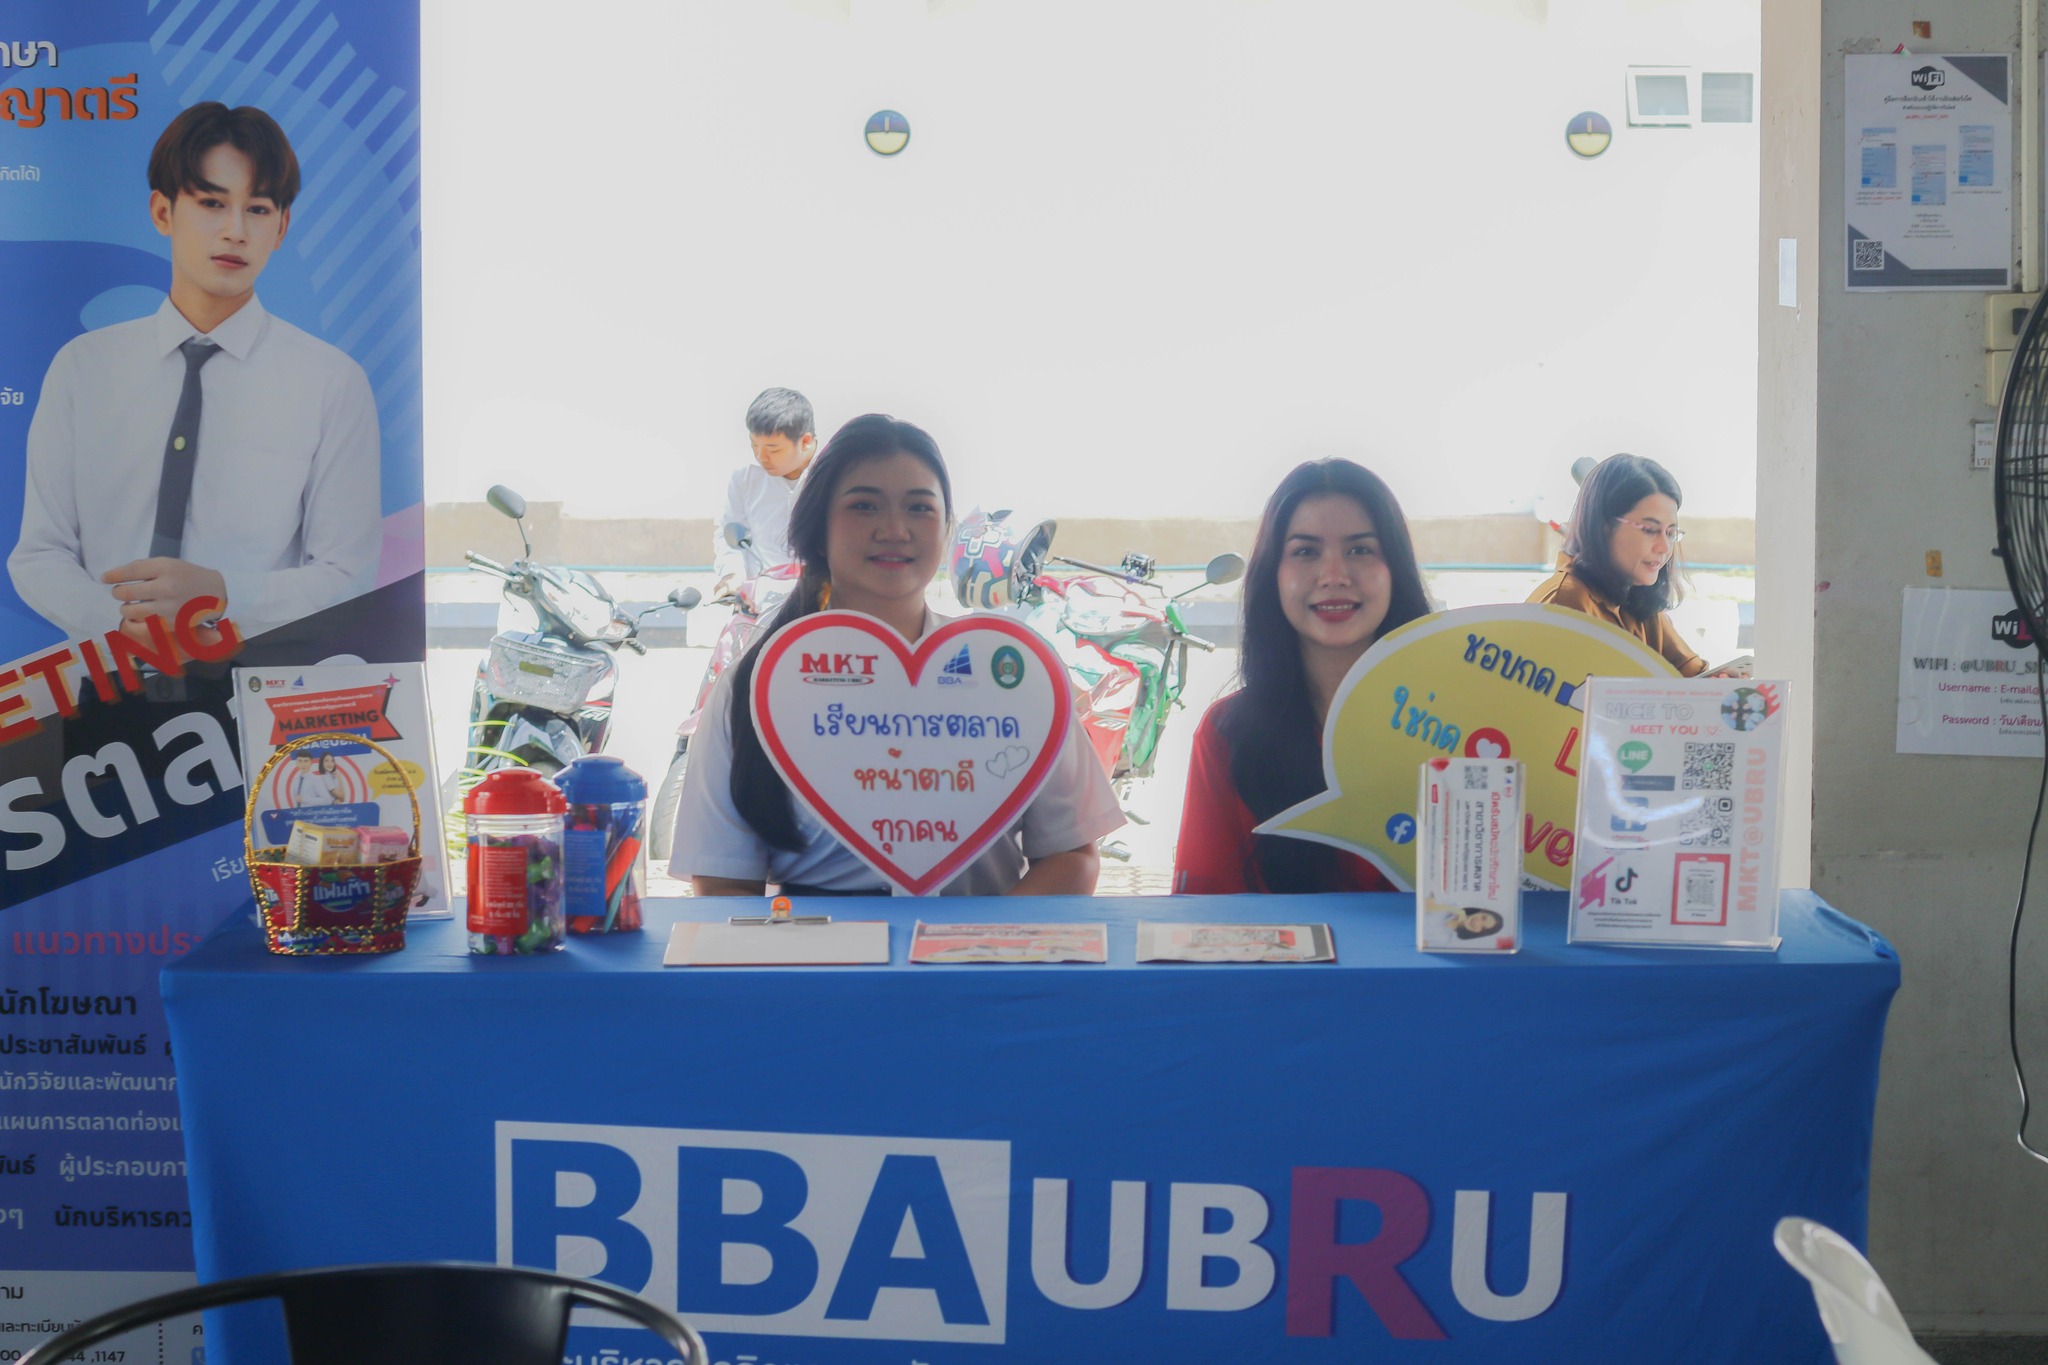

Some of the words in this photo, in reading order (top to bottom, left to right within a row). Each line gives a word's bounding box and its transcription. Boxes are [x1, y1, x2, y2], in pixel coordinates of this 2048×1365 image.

[799, 653, 879, 675] MKT
[1463, 633, 1556, 697] ชอบกด
[1914, 657, 1949, 671] WIFI
[937, 676, 963, 685] BBA
[1938, 683, 1991, 693] Username
[278, 710, 380, 732] MARKETING
[813, 703, 1019, 738] เรียนการตลาด
[1391, 685, 1461, 753] ใช่กด
[1605, 703, 1656, 720] NICE
[1662, 703, 1694, 720] TO
[1942, 715, 1990, 725] Password
[1630, 724, 1664, 735] MEET
[1669, 725, 1699, 735] YOU
[1621, 750, 1649, 761] LINE
[854, 747, 975, 792] หน้าตาดี
[872, 818, 958, 855] ทุกคน
[1737, 748, 1767, 912] MKT@UBRU
[511, 1138, 990, 1326] BBA
[1031, 1166, 1570, 1341] UBRU
